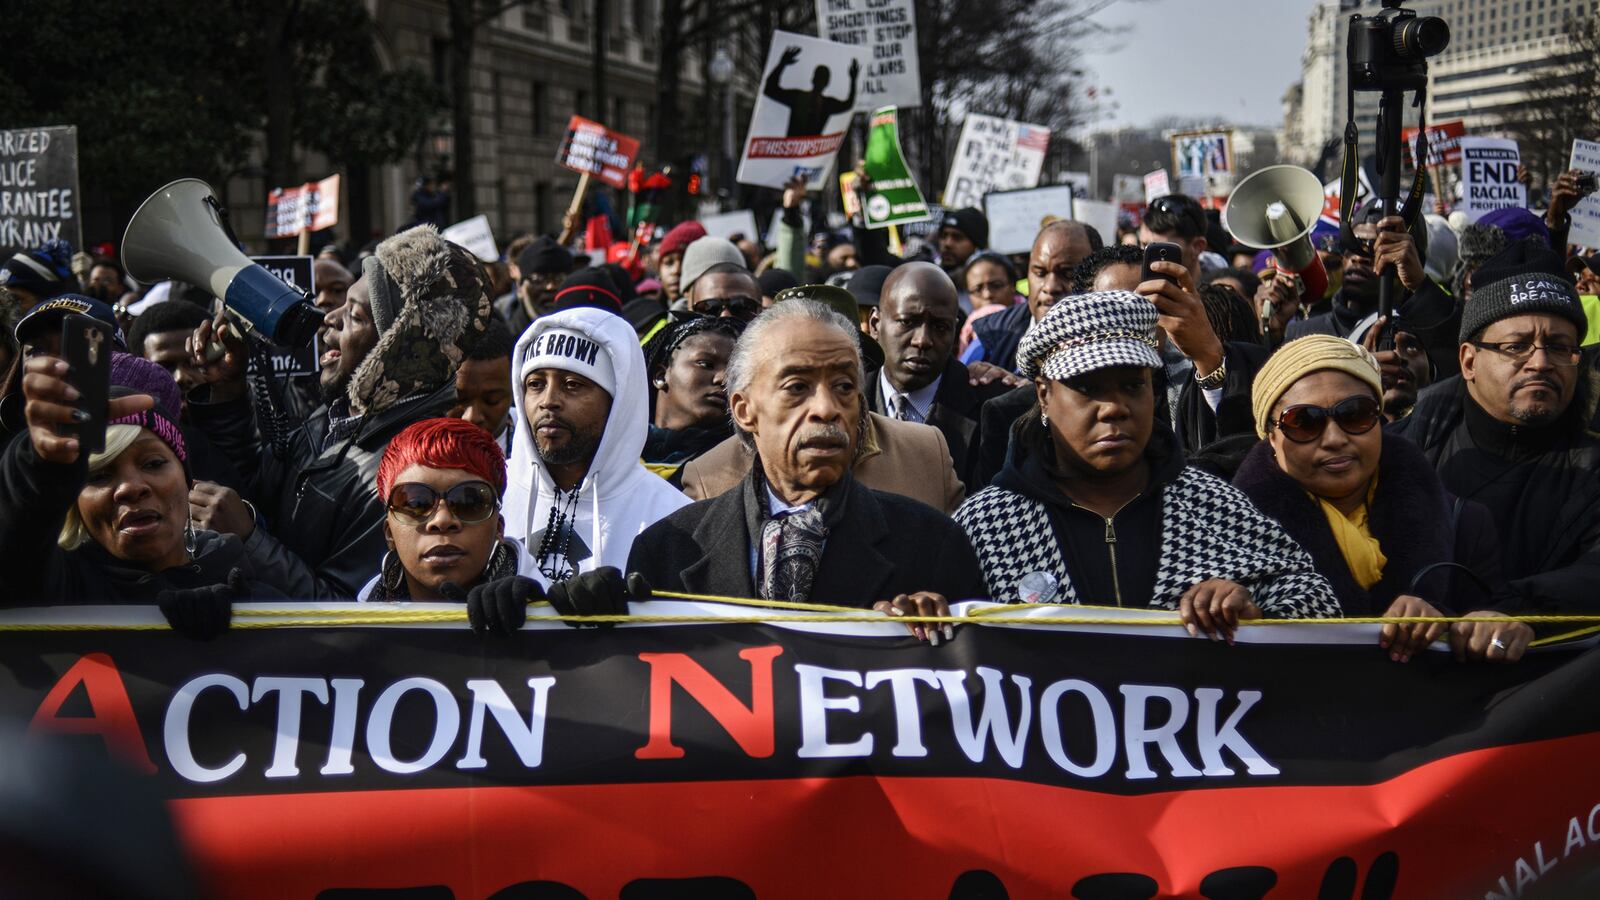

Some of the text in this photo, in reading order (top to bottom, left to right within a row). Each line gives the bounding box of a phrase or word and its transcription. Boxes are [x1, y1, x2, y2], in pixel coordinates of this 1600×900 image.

[875, 24, 912, 42] STOP
[1481, 150, 1507, 158] MARCH
[1469, 162, 1518, 184] END
[1470, 186, 1520, 200] RACIAL
[1510, 283, 1520, 292] I
[1510, 290, 1571, 305] BREATHE
[546, 333, 600, 367] BROWN
[28, 644, 1281, 783] ACTION NETWORK
